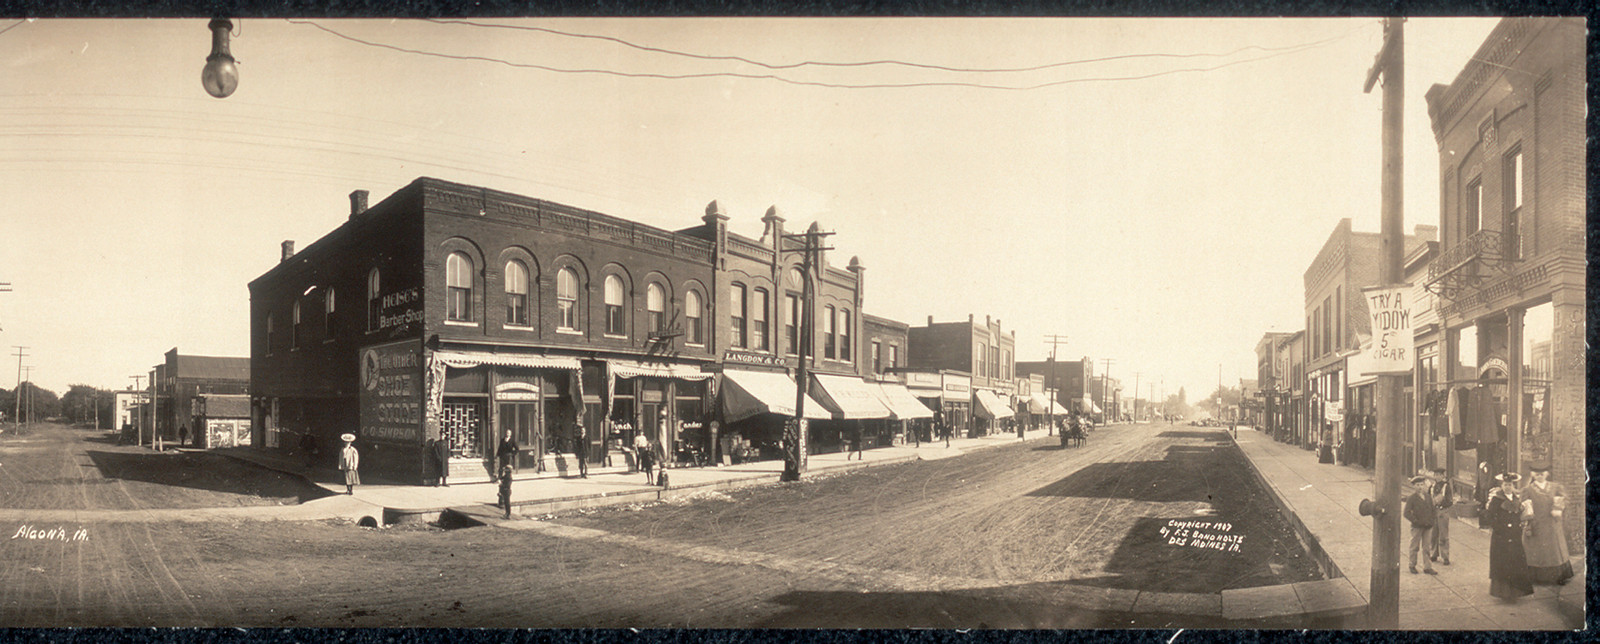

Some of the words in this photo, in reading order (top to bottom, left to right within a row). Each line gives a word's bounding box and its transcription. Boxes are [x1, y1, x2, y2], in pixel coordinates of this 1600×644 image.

[1370, 293, 1391, 309] TRY
[1394, 292, 1403, 310] A
[380, 313, 406, 329] Barber
[405, 309, 425, 324] Shop
[726, 353, 764, 363] LANGDON
[379, 375, 411, 397] SHOE
[379, 402, 419, 424] STORE
